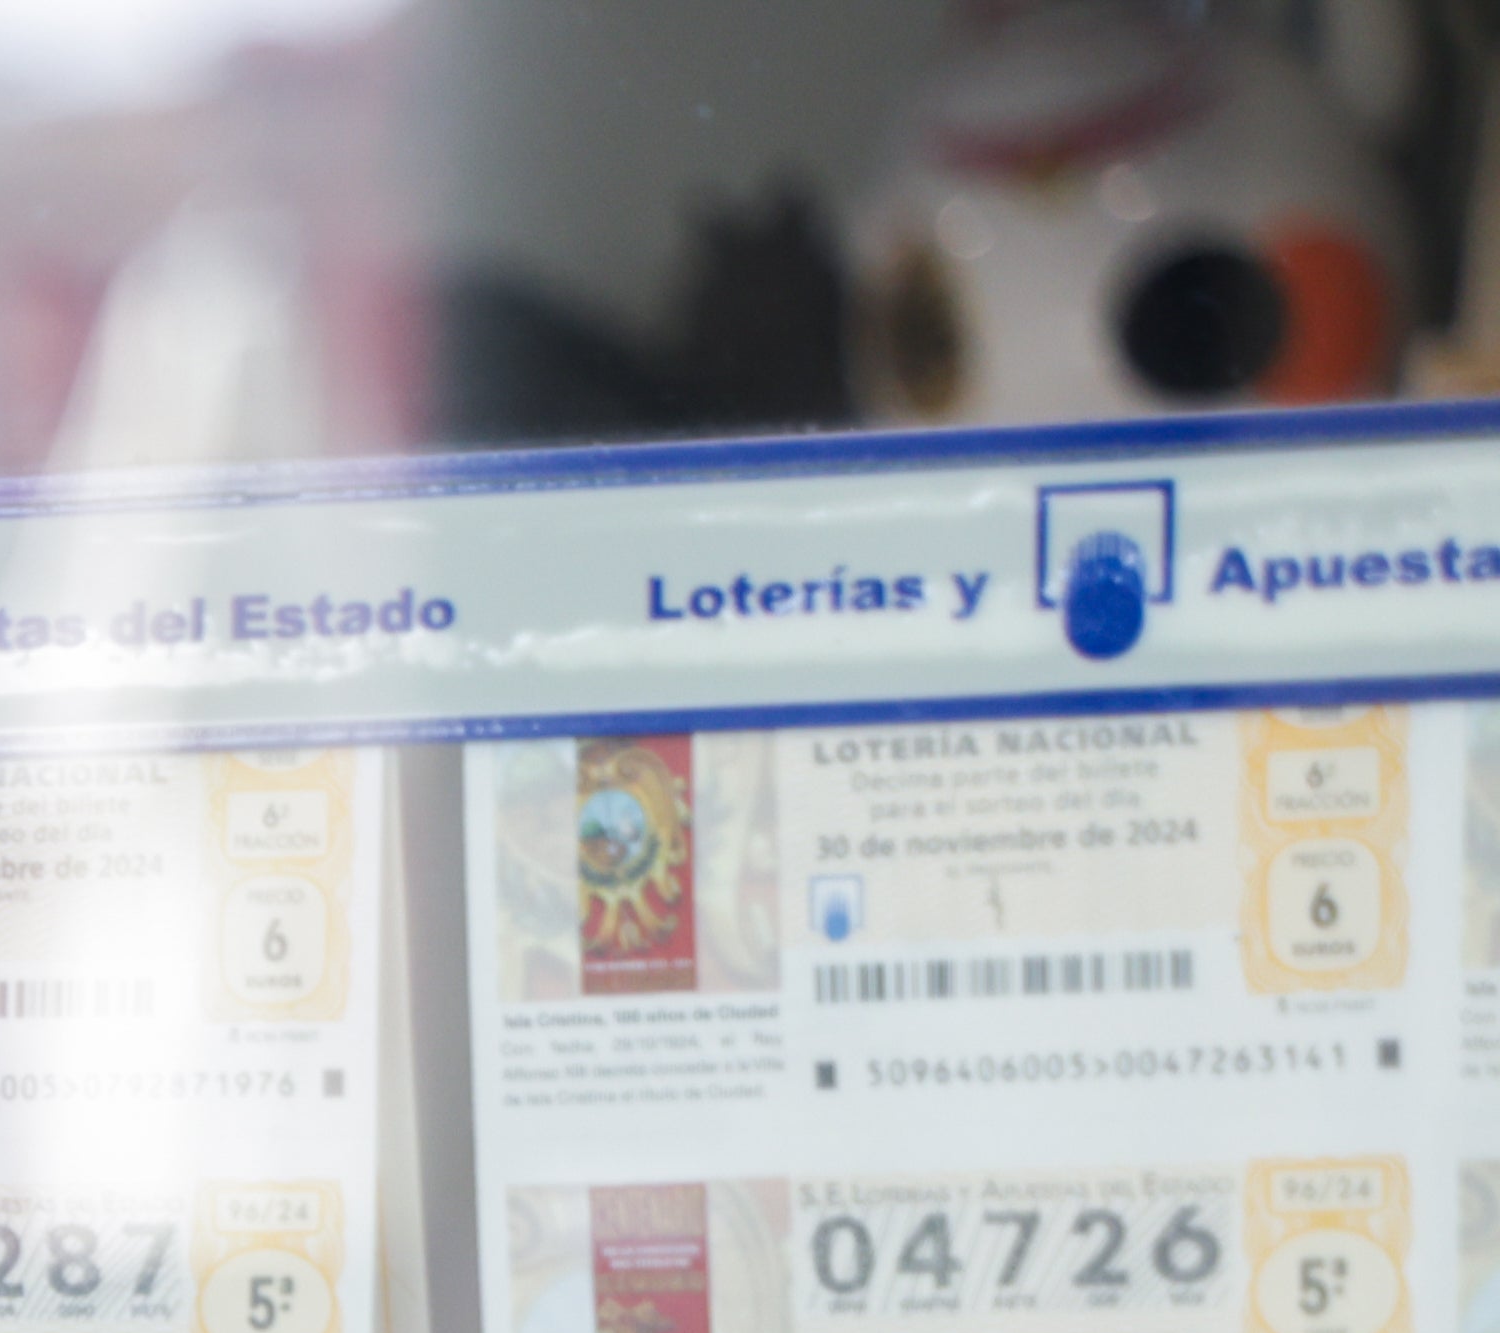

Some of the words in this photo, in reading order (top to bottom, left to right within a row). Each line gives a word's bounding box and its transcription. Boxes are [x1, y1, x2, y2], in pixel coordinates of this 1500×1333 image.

[111, 597, 206, 643] del
[230, 590, 457, 640] Estado
[648, 567, 923, 620] Loterías
[953, 572, 990, 618] y
[812, 1210, 1219, 1292] 04726
